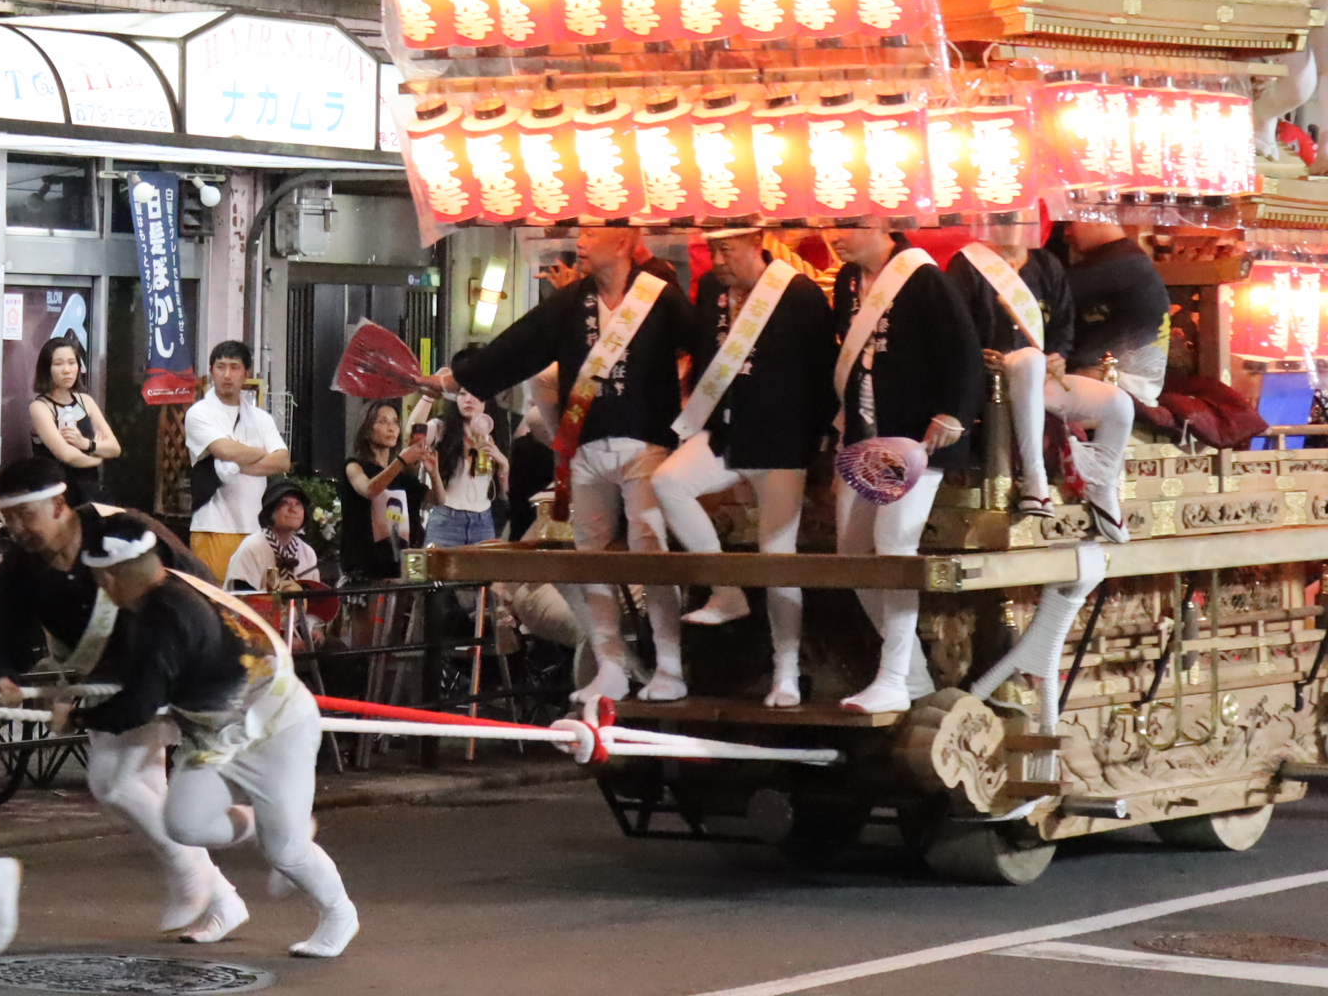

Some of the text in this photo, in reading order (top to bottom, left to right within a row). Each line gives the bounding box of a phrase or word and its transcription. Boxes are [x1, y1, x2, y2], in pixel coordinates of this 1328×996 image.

[204, 23, 272, 71] HAIR
[222, 79, 345, 132] ナカムラ
[147, 185, 175, 359] 白髪ぼかし
